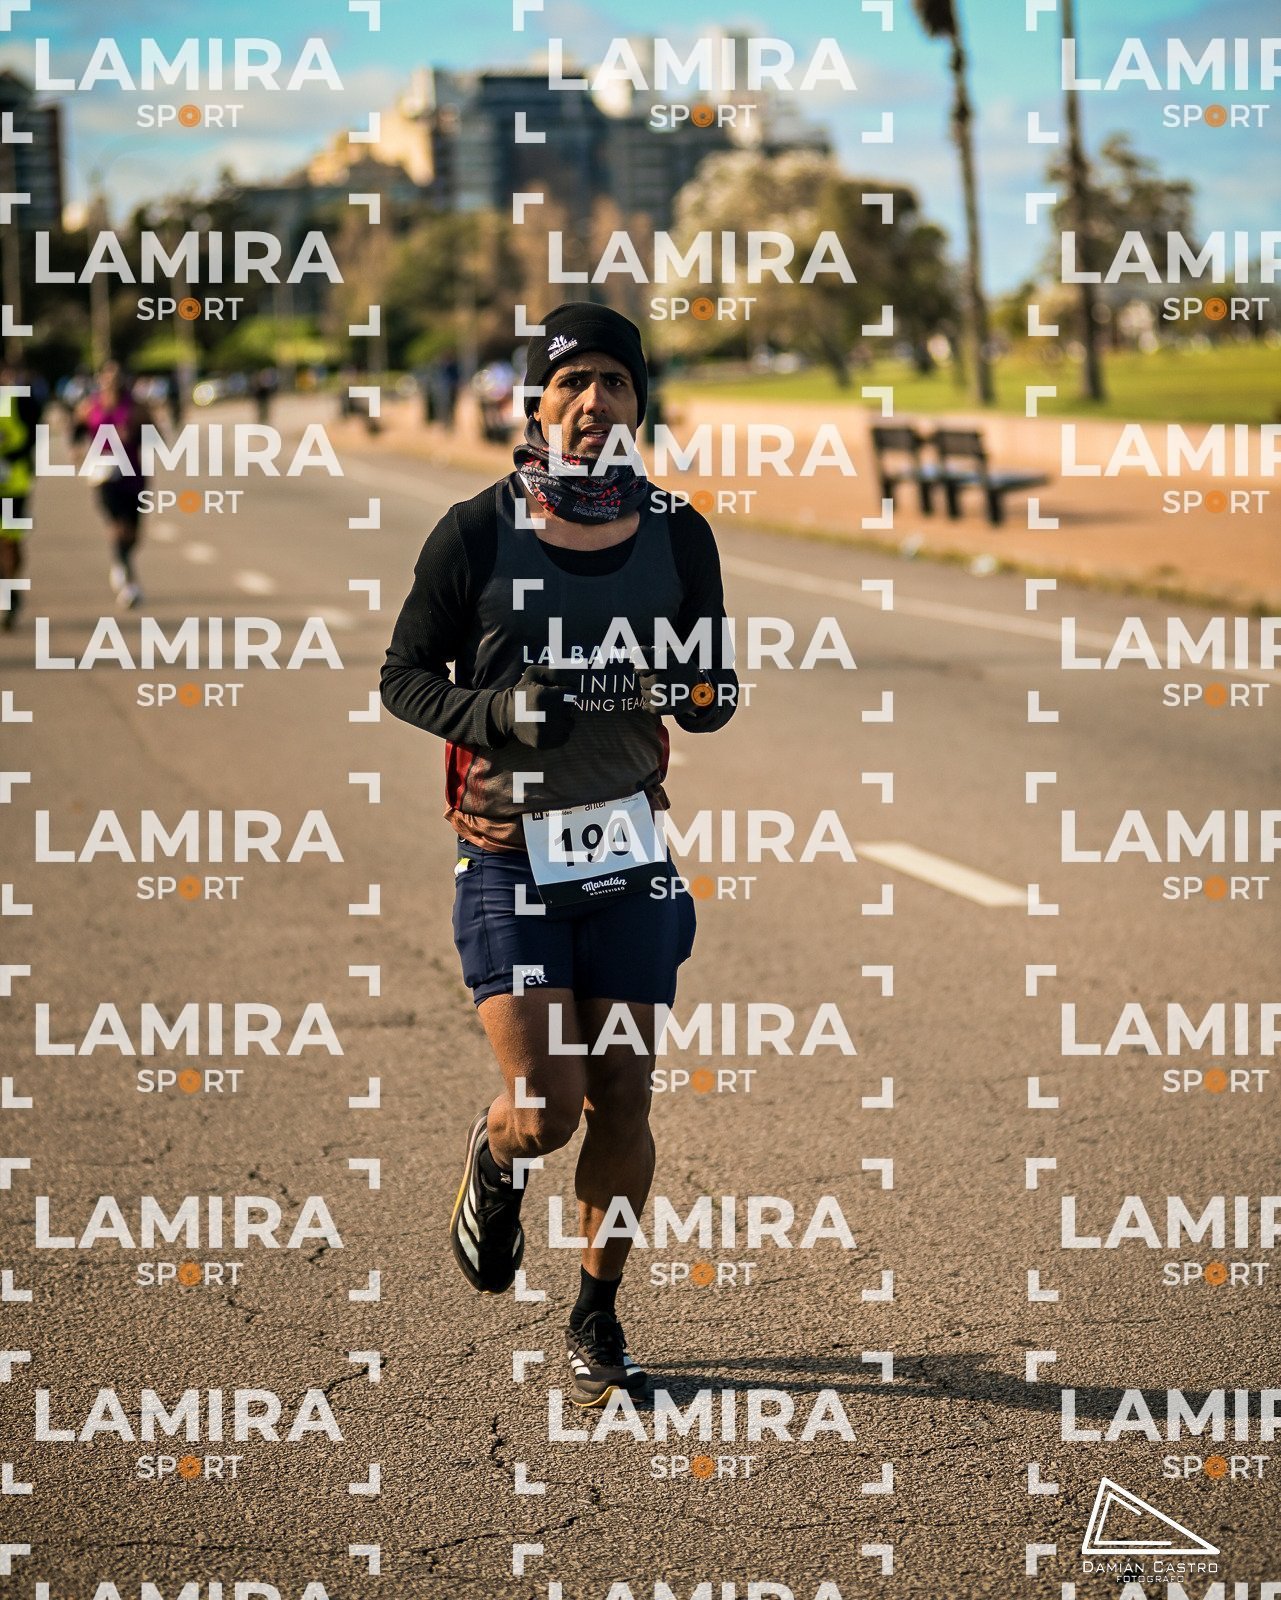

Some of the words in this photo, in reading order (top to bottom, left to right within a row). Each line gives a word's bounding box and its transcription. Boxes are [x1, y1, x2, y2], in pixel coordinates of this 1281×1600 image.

[523, 645, 555, 664] LA
[570, 645, 636, 664] BAN
[580, 673, 635, 693] ININ
[574, 699, 615, 712] NING
[553, 816, 632, 867] 190
[581, 876, 627, 892] Maratón
[590, 887, 625, 896] MONTEVIDEO
